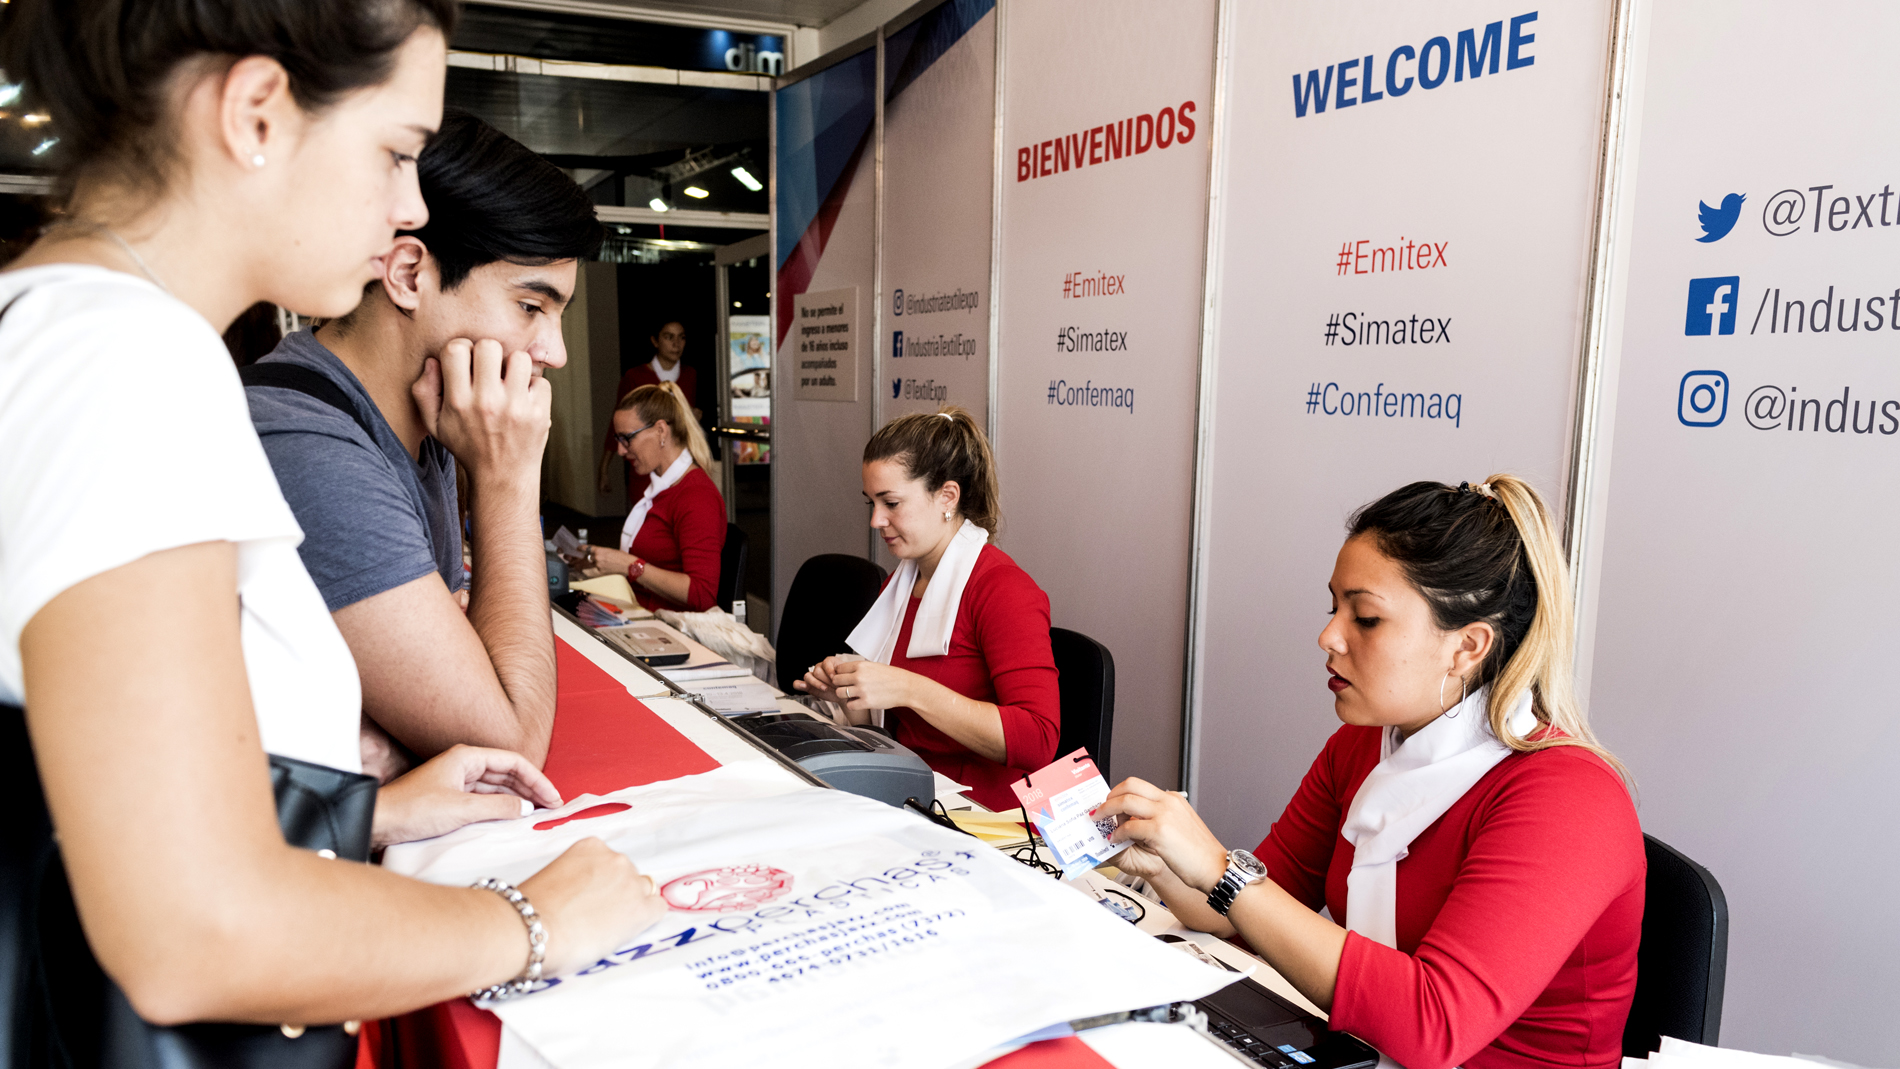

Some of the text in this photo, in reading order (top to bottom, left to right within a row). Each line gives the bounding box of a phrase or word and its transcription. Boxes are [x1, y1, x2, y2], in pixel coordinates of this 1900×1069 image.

[1292, 11, 1538, 118] WELCOME
[1017, 101, 1196, 183] BIENVENIDOS
[1337, 236, 1448, 277] #Emitex
[1063, 271, 1125, 299] #Emitex
[801, 303, 844, 319] No se permite el
[906, 287, 979, 316] @industriatextilexpo
[801, 324, 821, 338] ingreso
[826, 323, 849, 334] menores
[1057, 325, 1128, 353] #Simatex
[1324, 312, 1451, 347] #Simatex
[801, 341, 808, 352] de
[816, 339, 828, 352] años
[829, 339, 848, 351] incluso
[905, 333, 976, 361] /IndustriaTextilExpo
[801, 358, 837, 371] acompañados
[801, 377, 810, 389] por
[811, 377, 817, 386] un
[904, 379, 947, 405] @TextilExpo
[1047, 380, 1134, 415] #Confemaq
[1306, 381, 1463, 428] #Confemaq
[1745, 385, 1900, 435] @indus
[1022, 788, 1044, 806] 2018
[696, 908, 923, 979] www.perchasjazz.com
